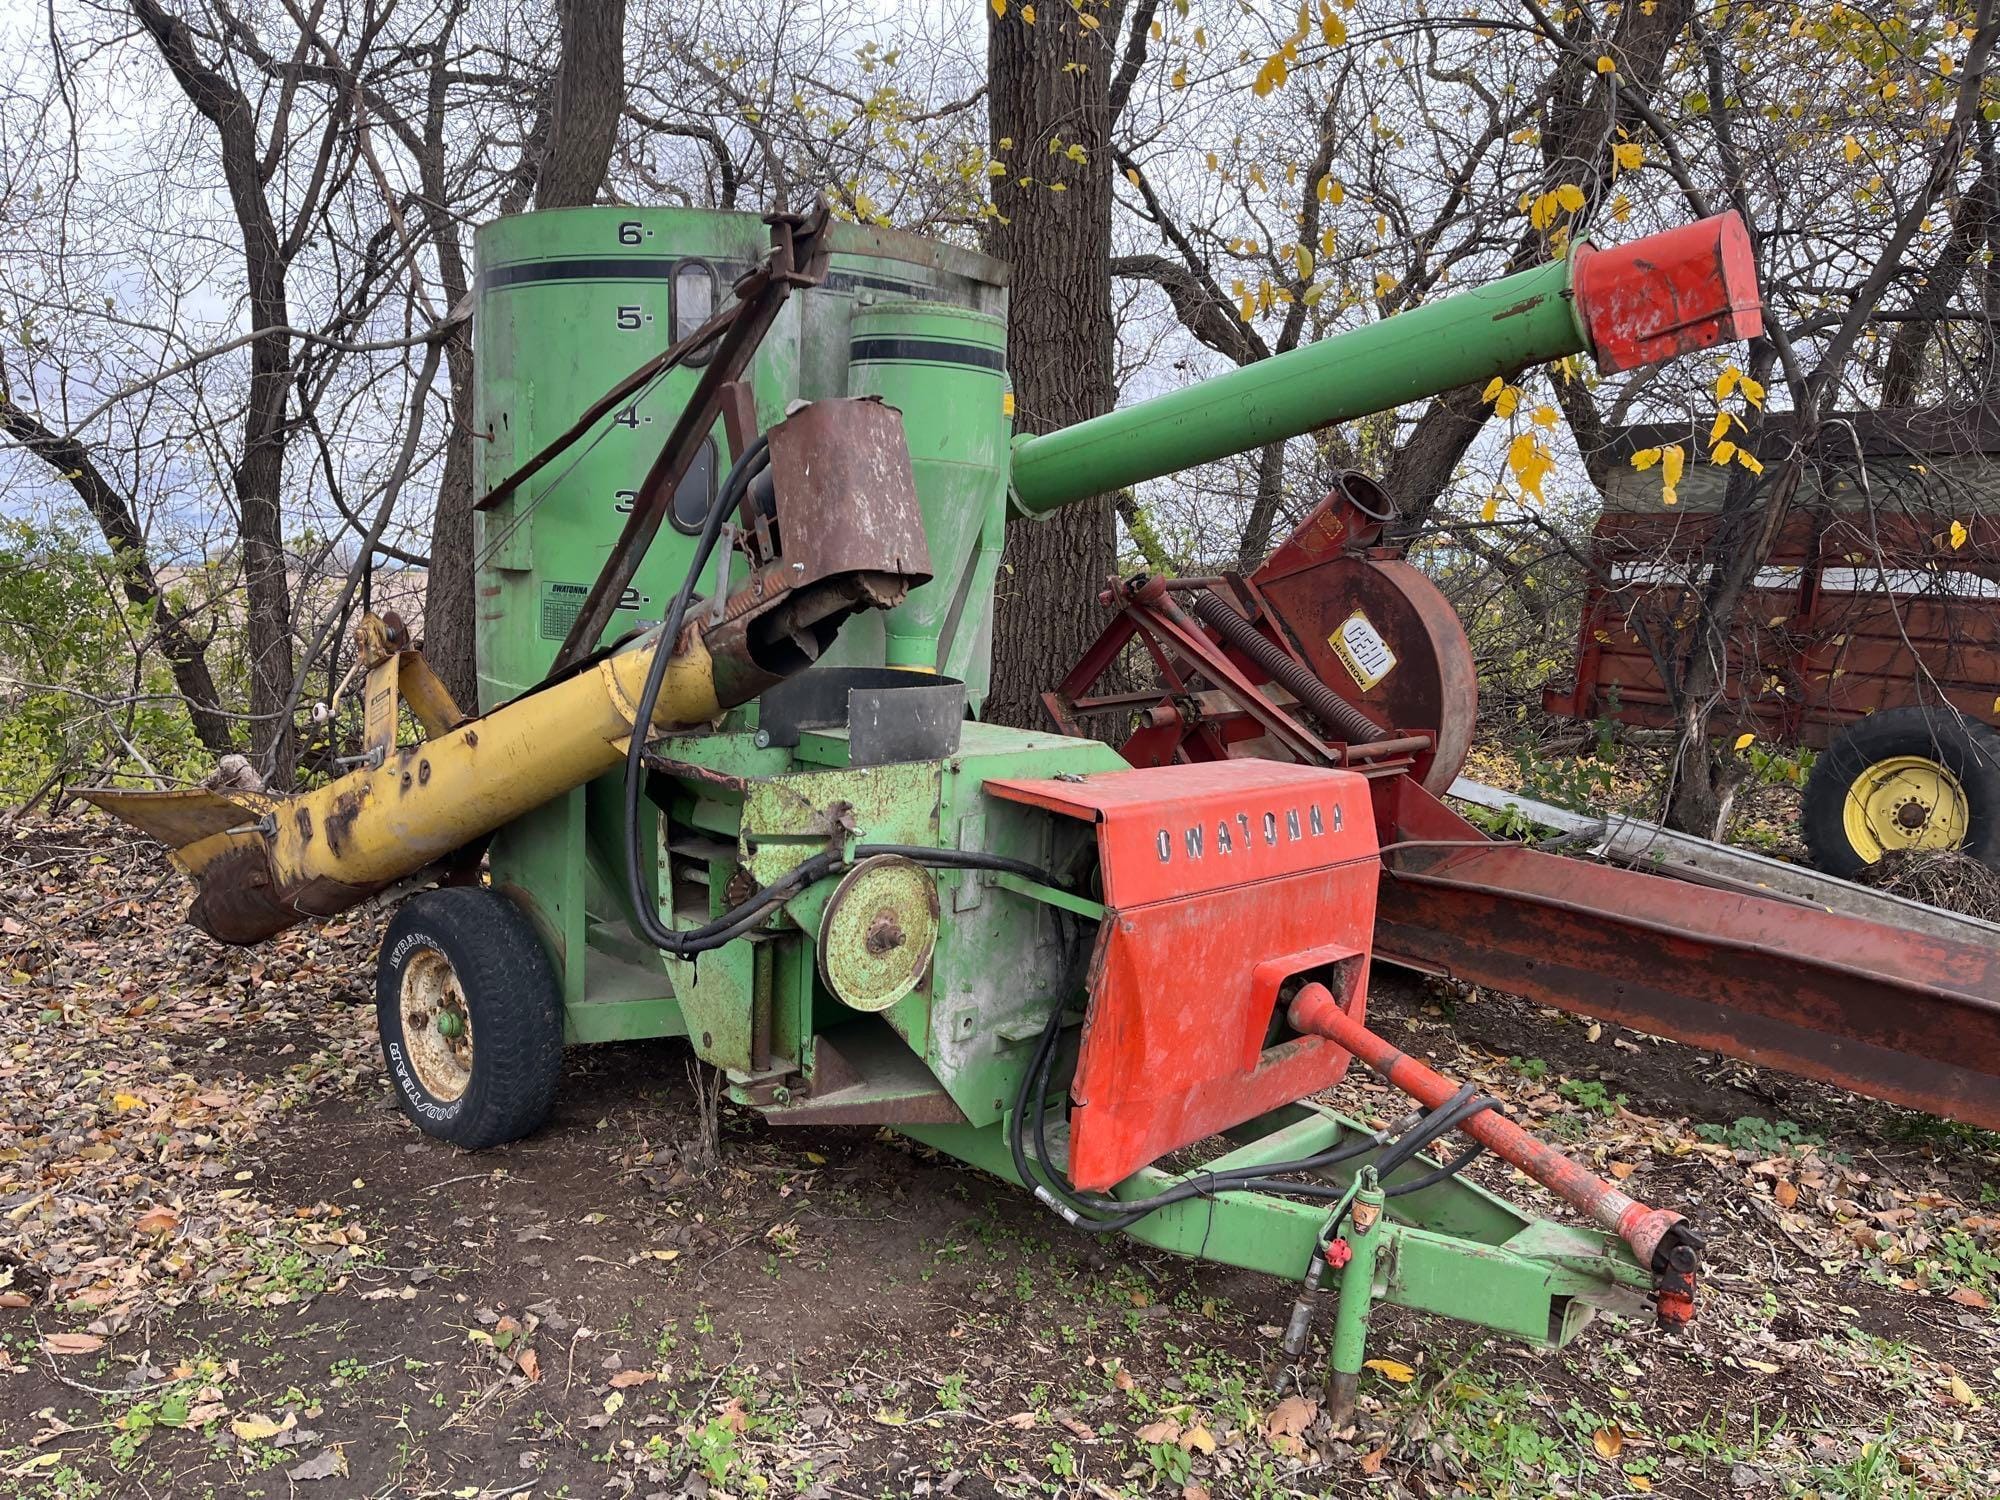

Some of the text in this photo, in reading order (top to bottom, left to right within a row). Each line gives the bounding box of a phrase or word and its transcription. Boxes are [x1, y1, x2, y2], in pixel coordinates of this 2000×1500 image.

[552, 584, 588, 595] OWATONNA
[1331, 641, 1366, 686] HI-THROW
[1343, 626, 1386, 676] GEHL
[1156, 803, 1344, 864] OWATONNA
